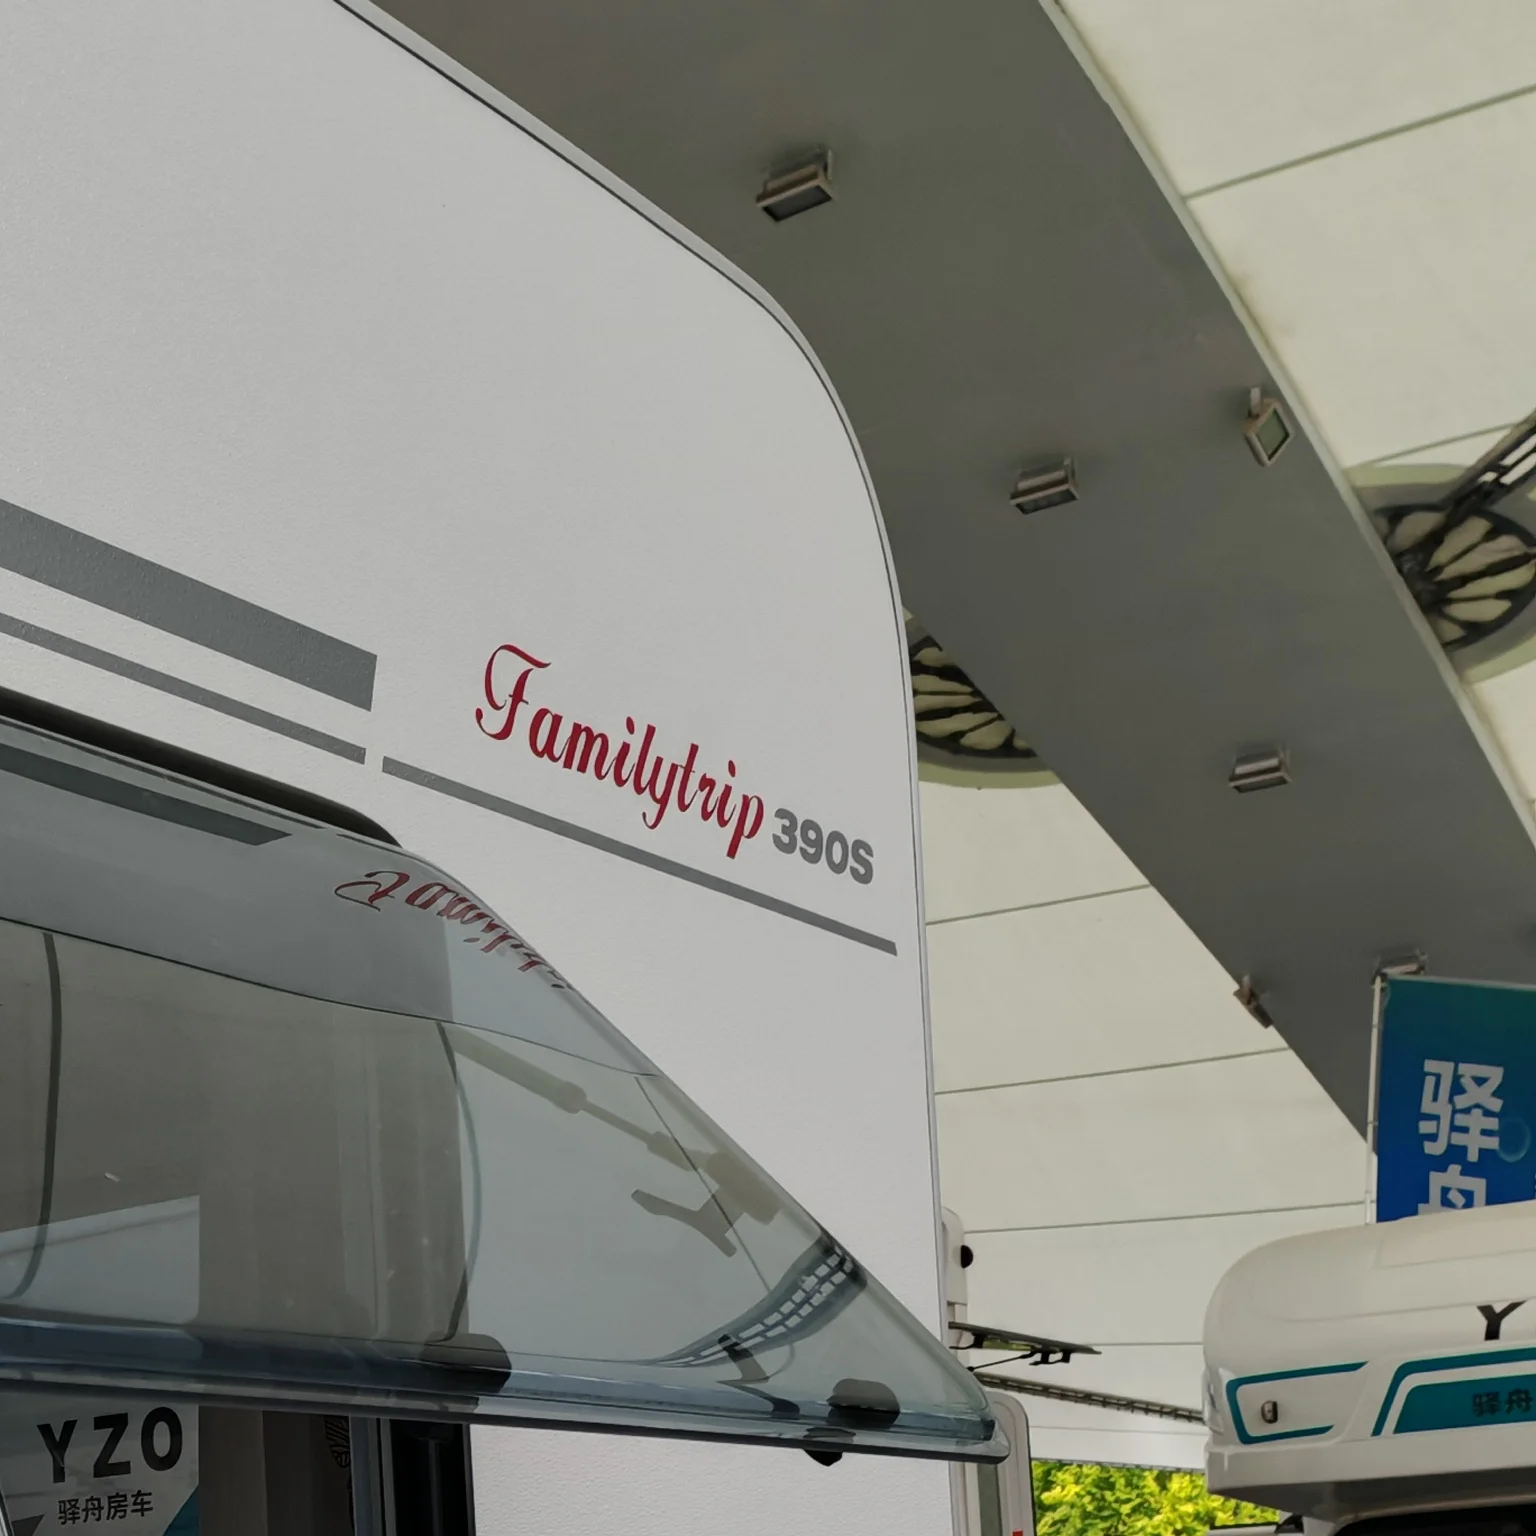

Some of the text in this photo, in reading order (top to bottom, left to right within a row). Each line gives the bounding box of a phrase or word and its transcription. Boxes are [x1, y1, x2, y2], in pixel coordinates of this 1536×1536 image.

[475, 643, 874, 885] Familytrip 390S
[37, 1406, 183, 1483] YZO
[57, 1490, 154, 1525] 驿舟房车
